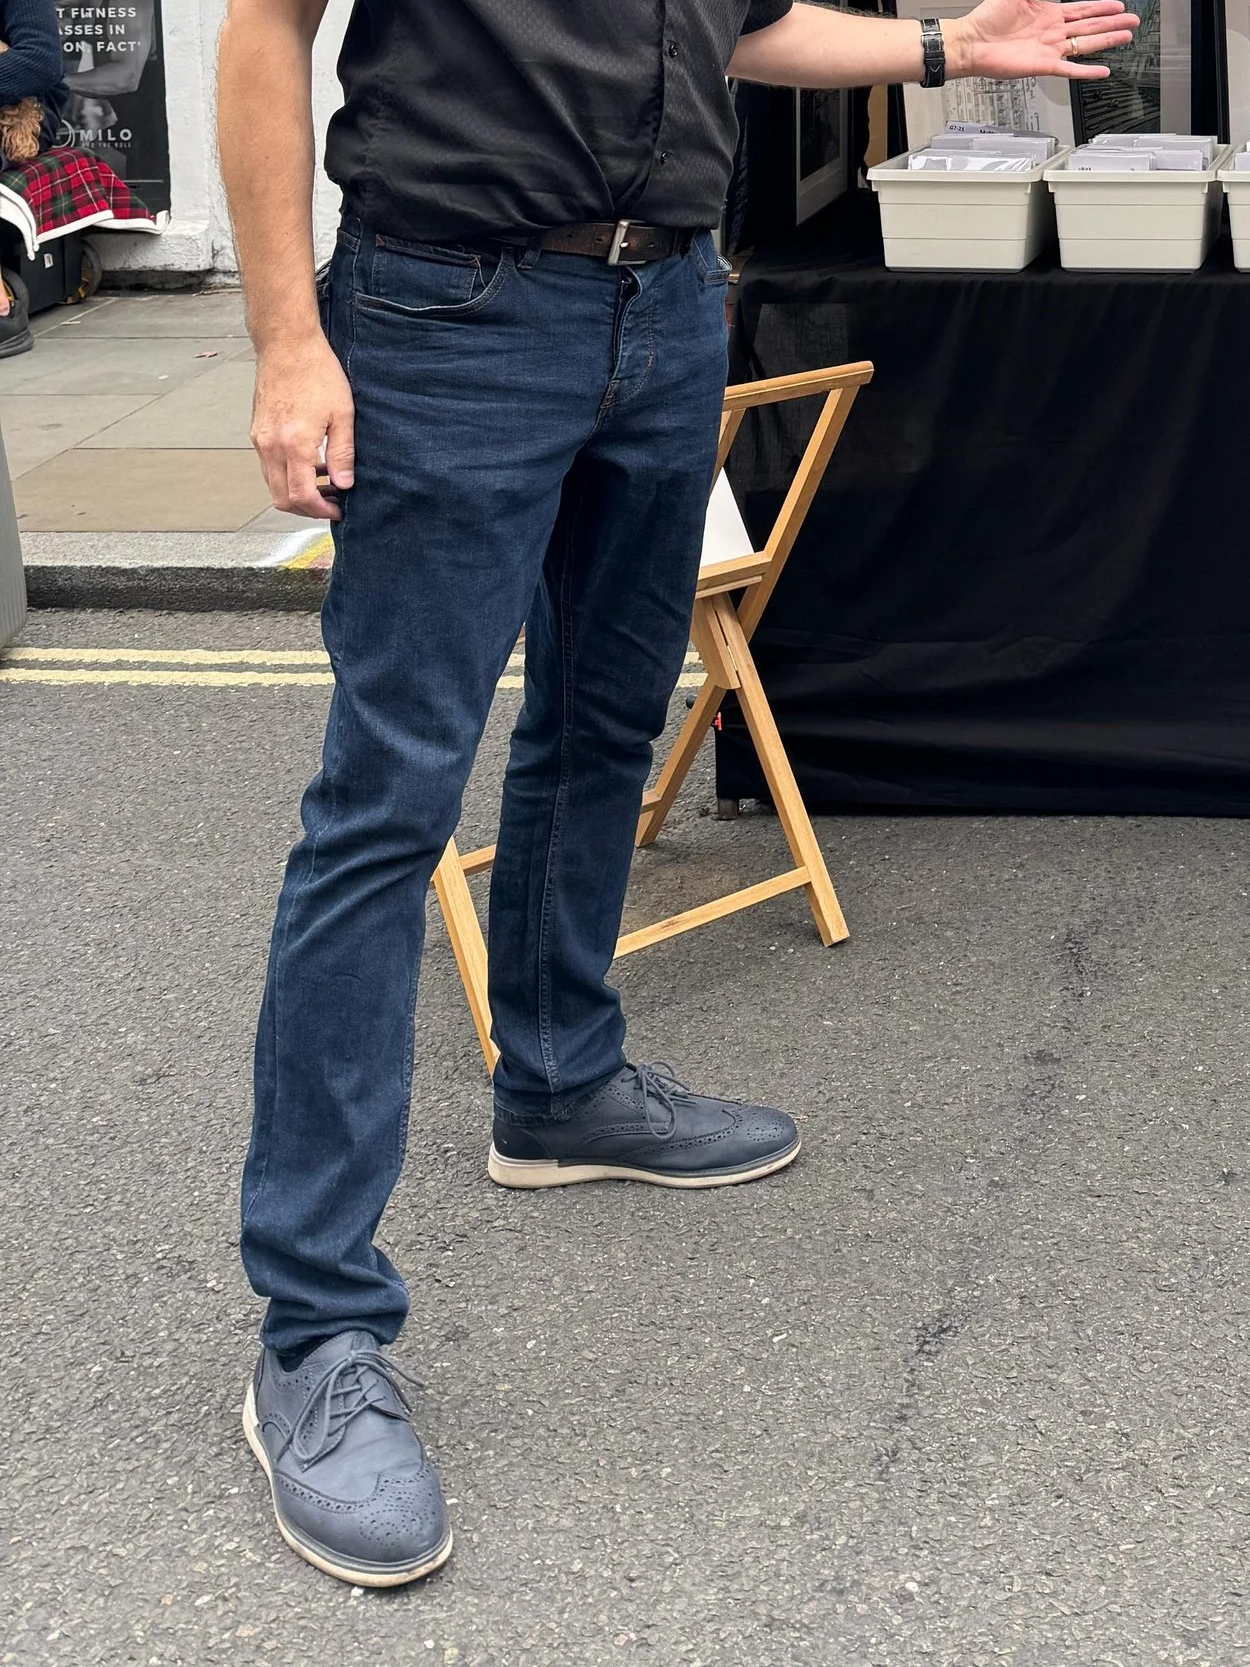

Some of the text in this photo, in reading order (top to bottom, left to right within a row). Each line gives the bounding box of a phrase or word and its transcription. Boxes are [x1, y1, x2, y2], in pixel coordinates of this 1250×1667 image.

[71, 7, 137, 19] FITNESS
[109, 24, 125, 36] IN
[79, 128, 133, 142] MILO
